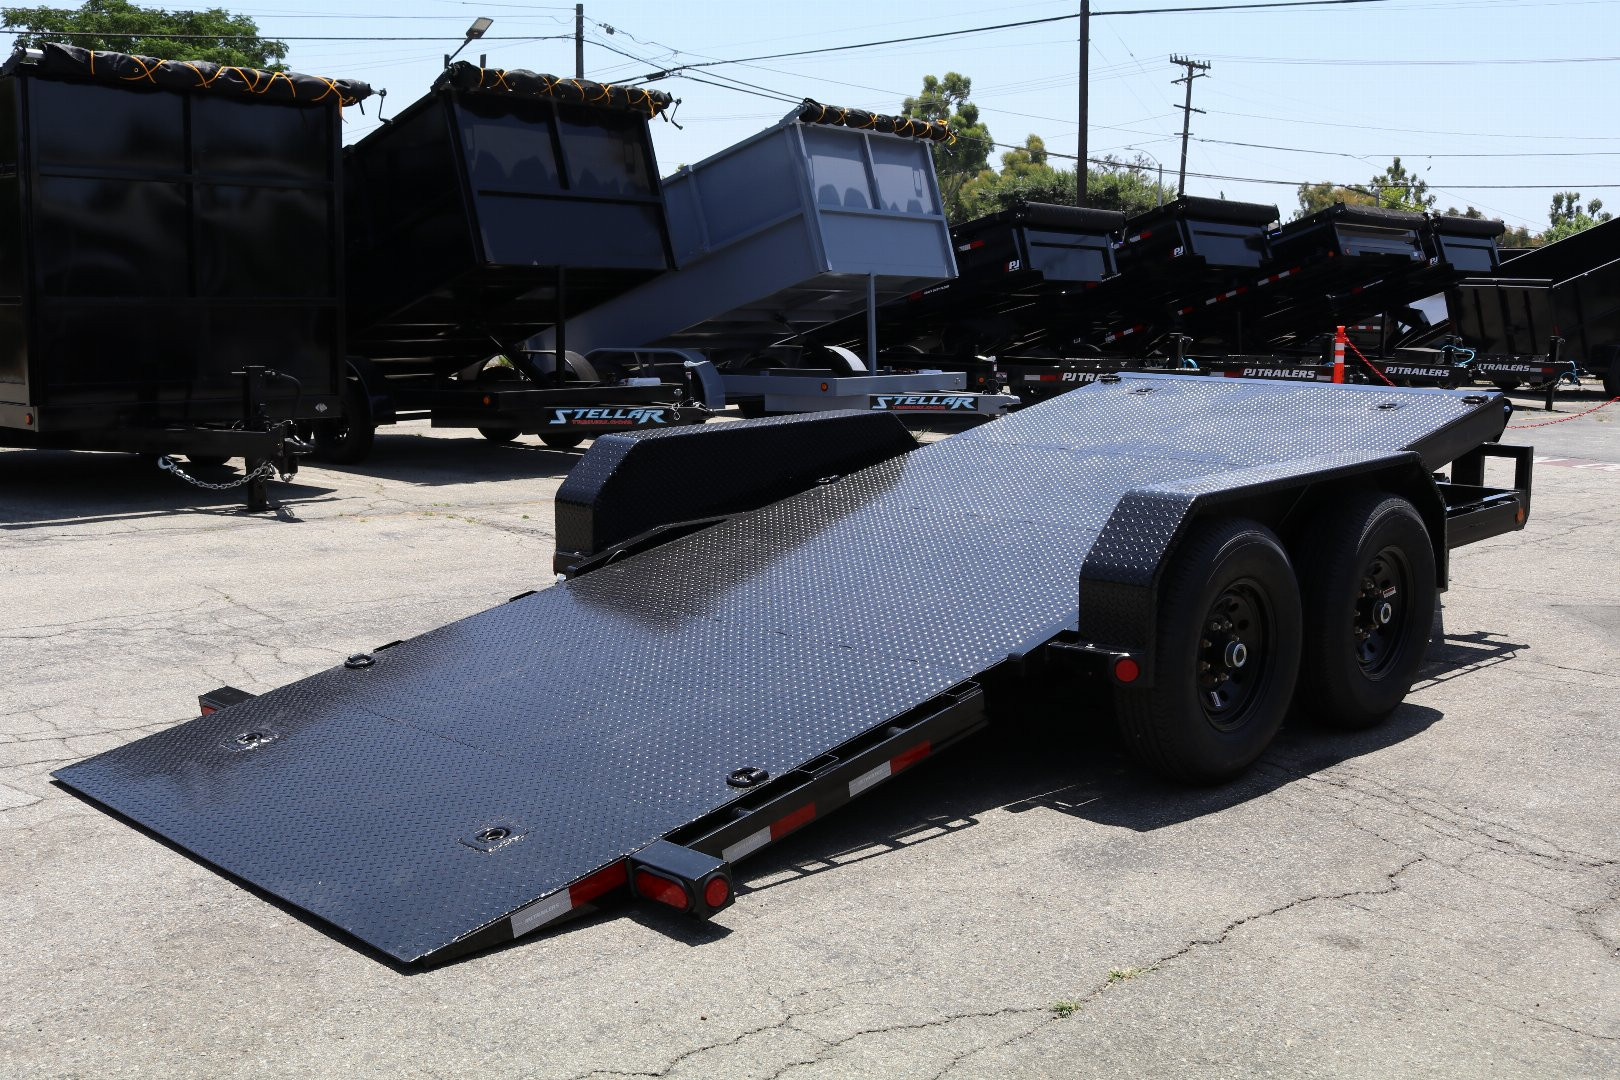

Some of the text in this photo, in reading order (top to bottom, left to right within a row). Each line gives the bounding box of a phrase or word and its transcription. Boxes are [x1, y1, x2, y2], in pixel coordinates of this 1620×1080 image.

[1009, 260, 1020, 269] PJ
[1397, 367, 1450, 377] TRAILERS
[1482, 363, 1530, 372] TRAILERS
[1257, 368, 1316, 378] TRAILERS
[871, 396, 977, 410] STELLAR
[548, 408, 667, 425] STELLAR
